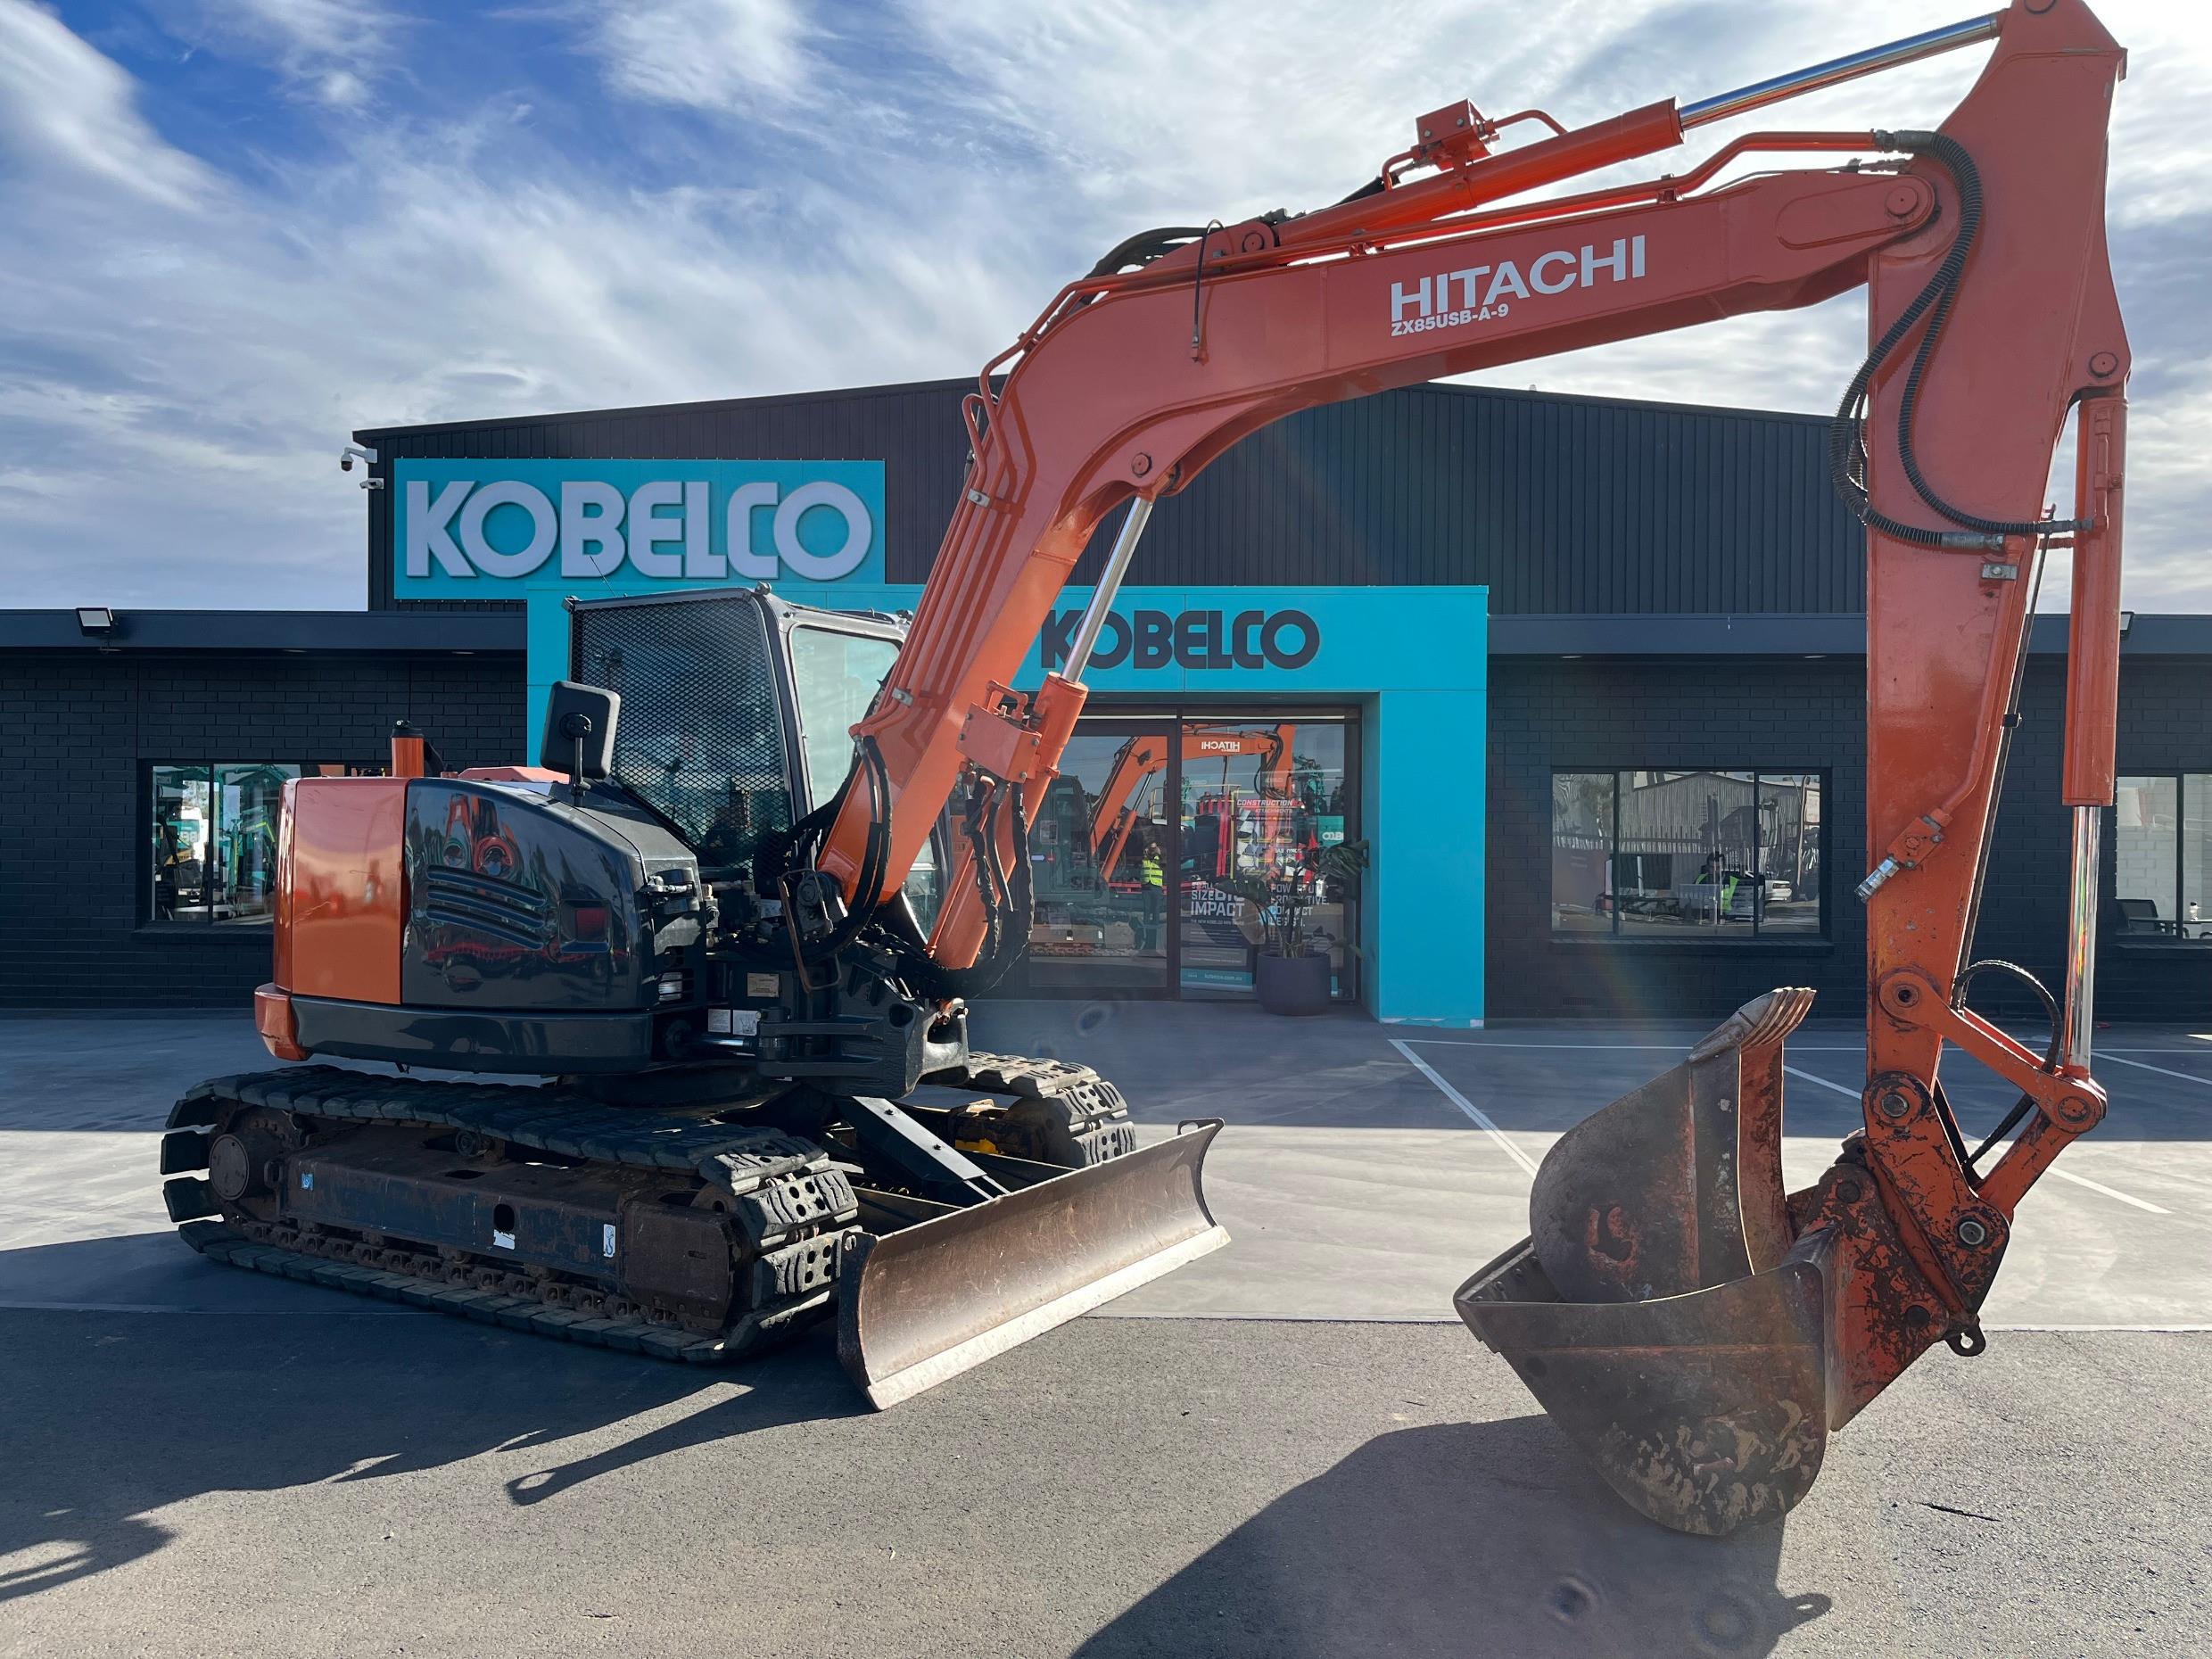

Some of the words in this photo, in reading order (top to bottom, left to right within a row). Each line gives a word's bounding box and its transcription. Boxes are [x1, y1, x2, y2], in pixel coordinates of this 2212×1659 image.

[1391, 235, 1646, 322] HITACHI
[1391, 303, 1509, 337] ZX85USB-A-9
[406, 480, 872, 581] KOBELCO
[1041, 609, 1320, 670] KOBELCO
[1191, 889, 1215, 901] SIZE
[1191, 901, 1245, 917] IMPACT
